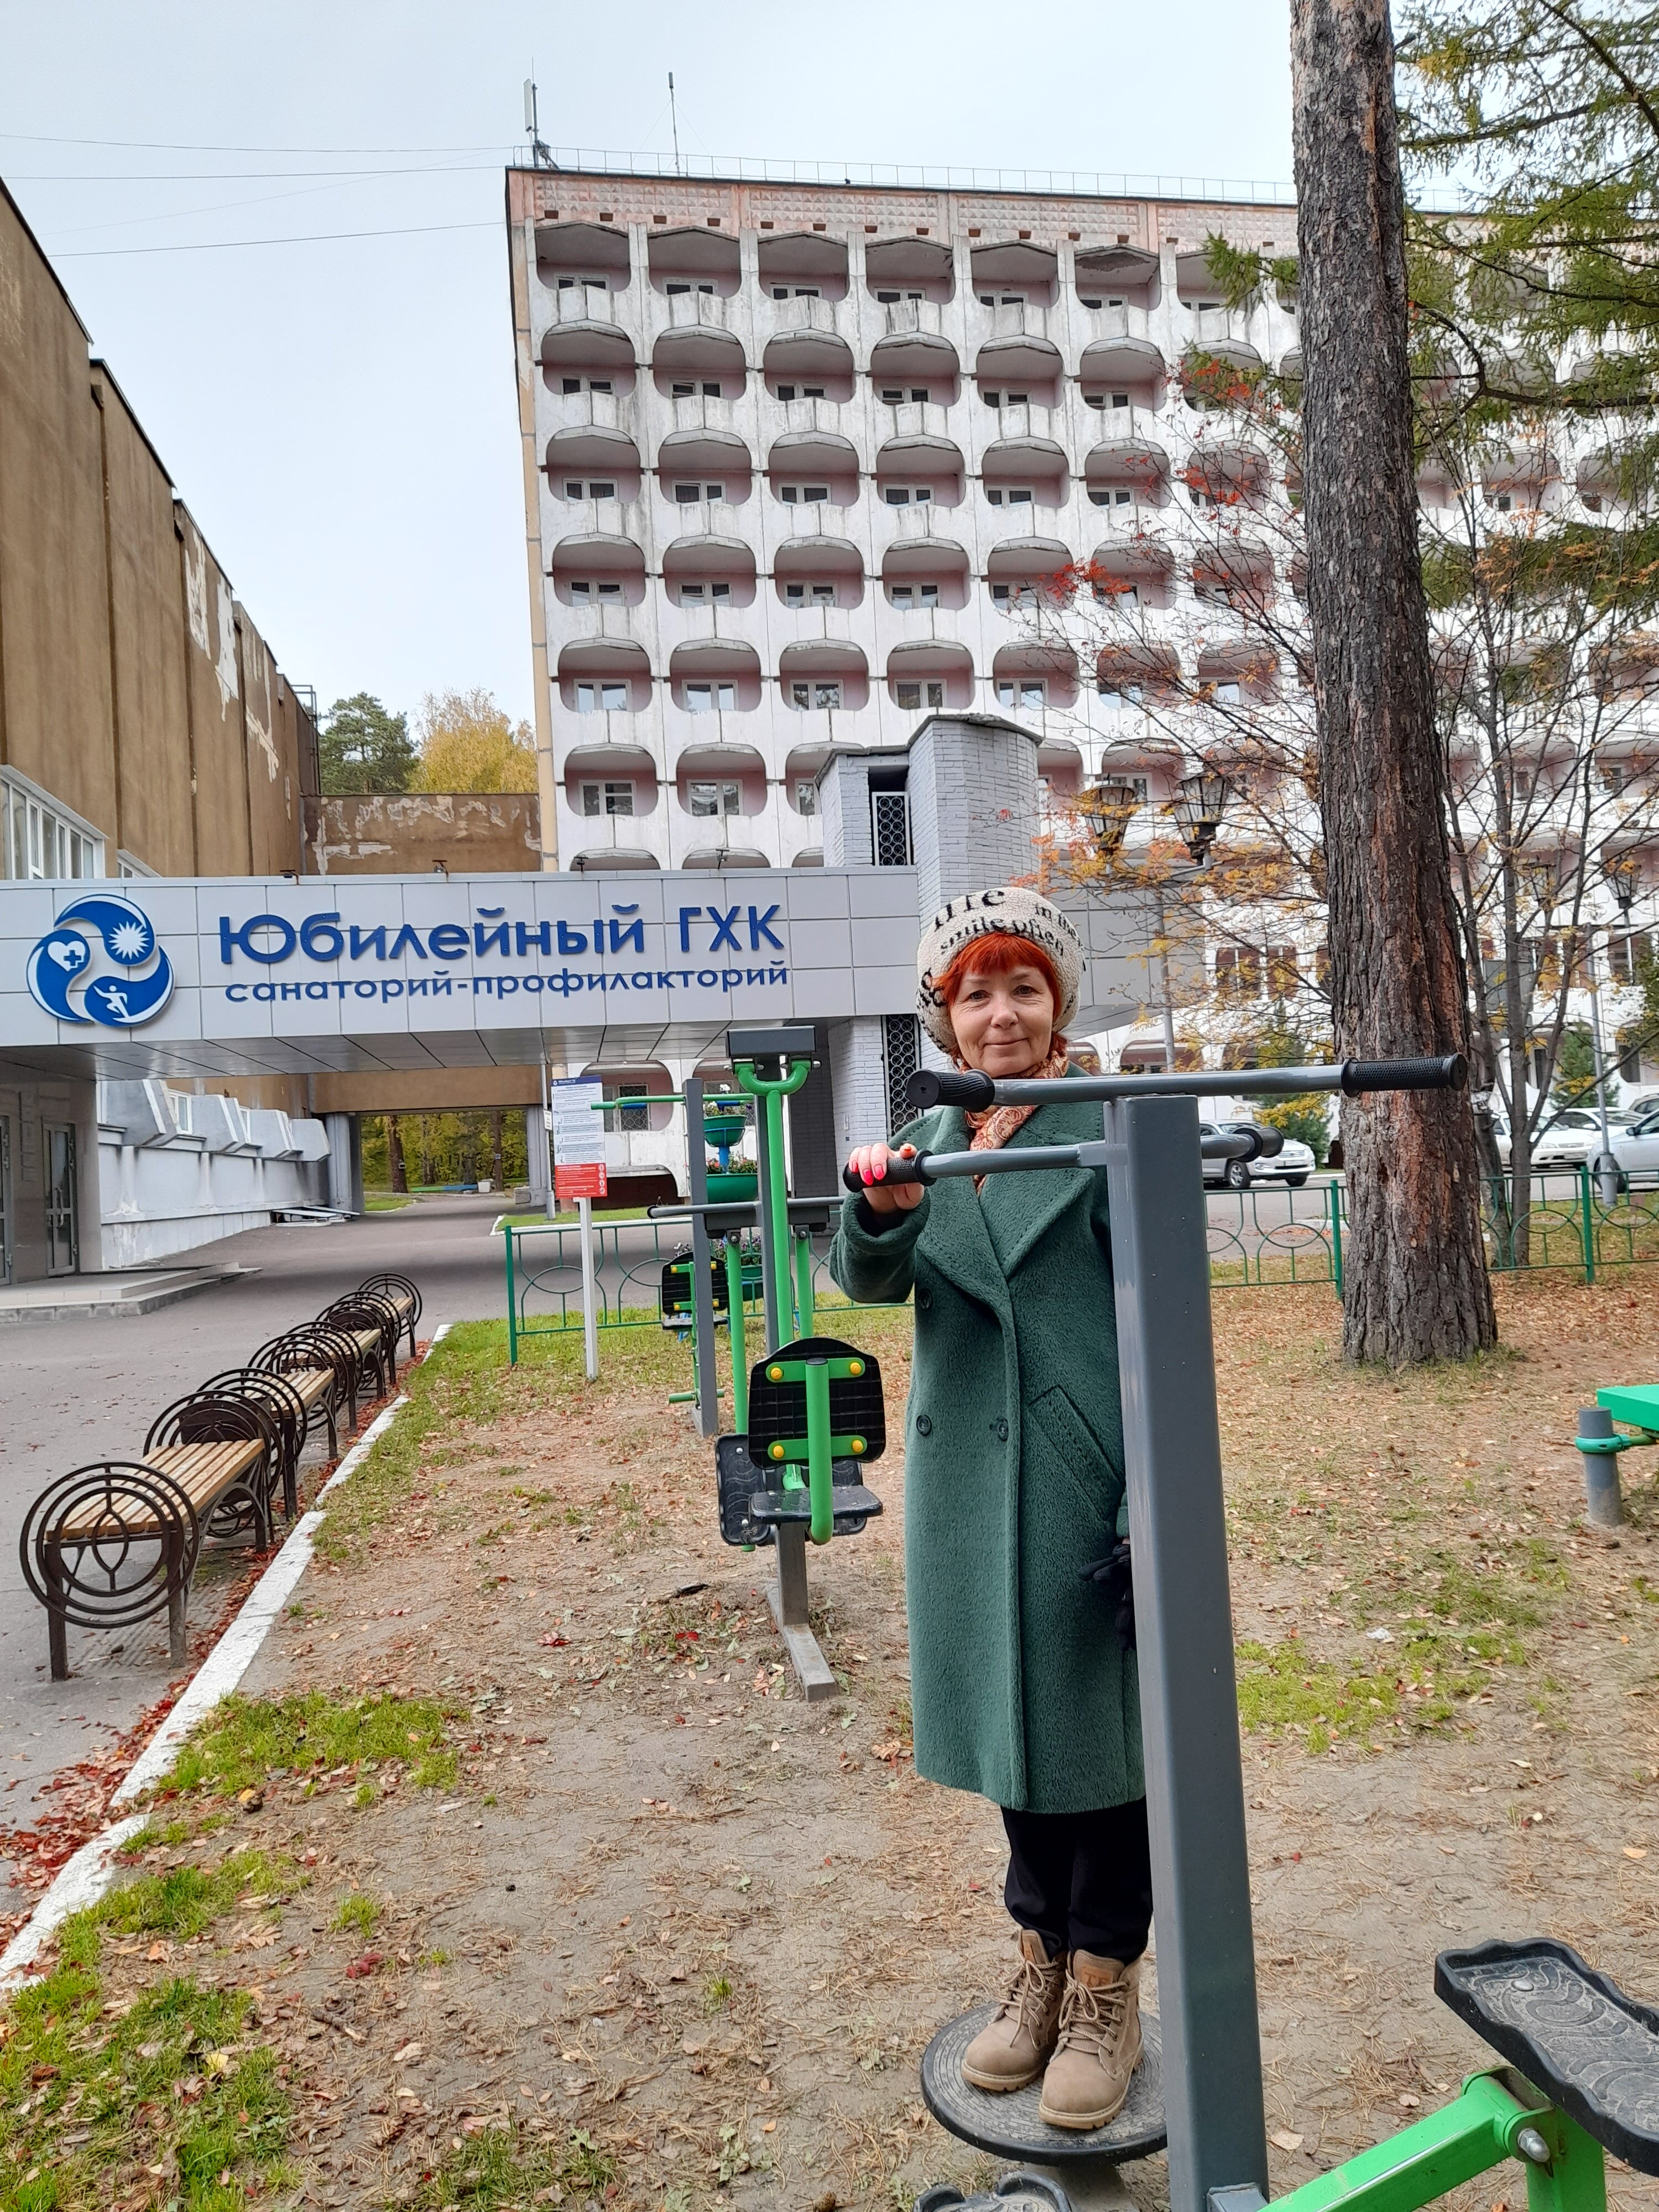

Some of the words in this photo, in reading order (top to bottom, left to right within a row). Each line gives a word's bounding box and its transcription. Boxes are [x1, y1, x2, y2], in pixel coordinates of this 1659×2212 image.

[220, 904, 644, 964] Юбилейный
[679, 904, 785, 952] ГХК
[225, 960, 787, 1003] санаторий-профилакторий
